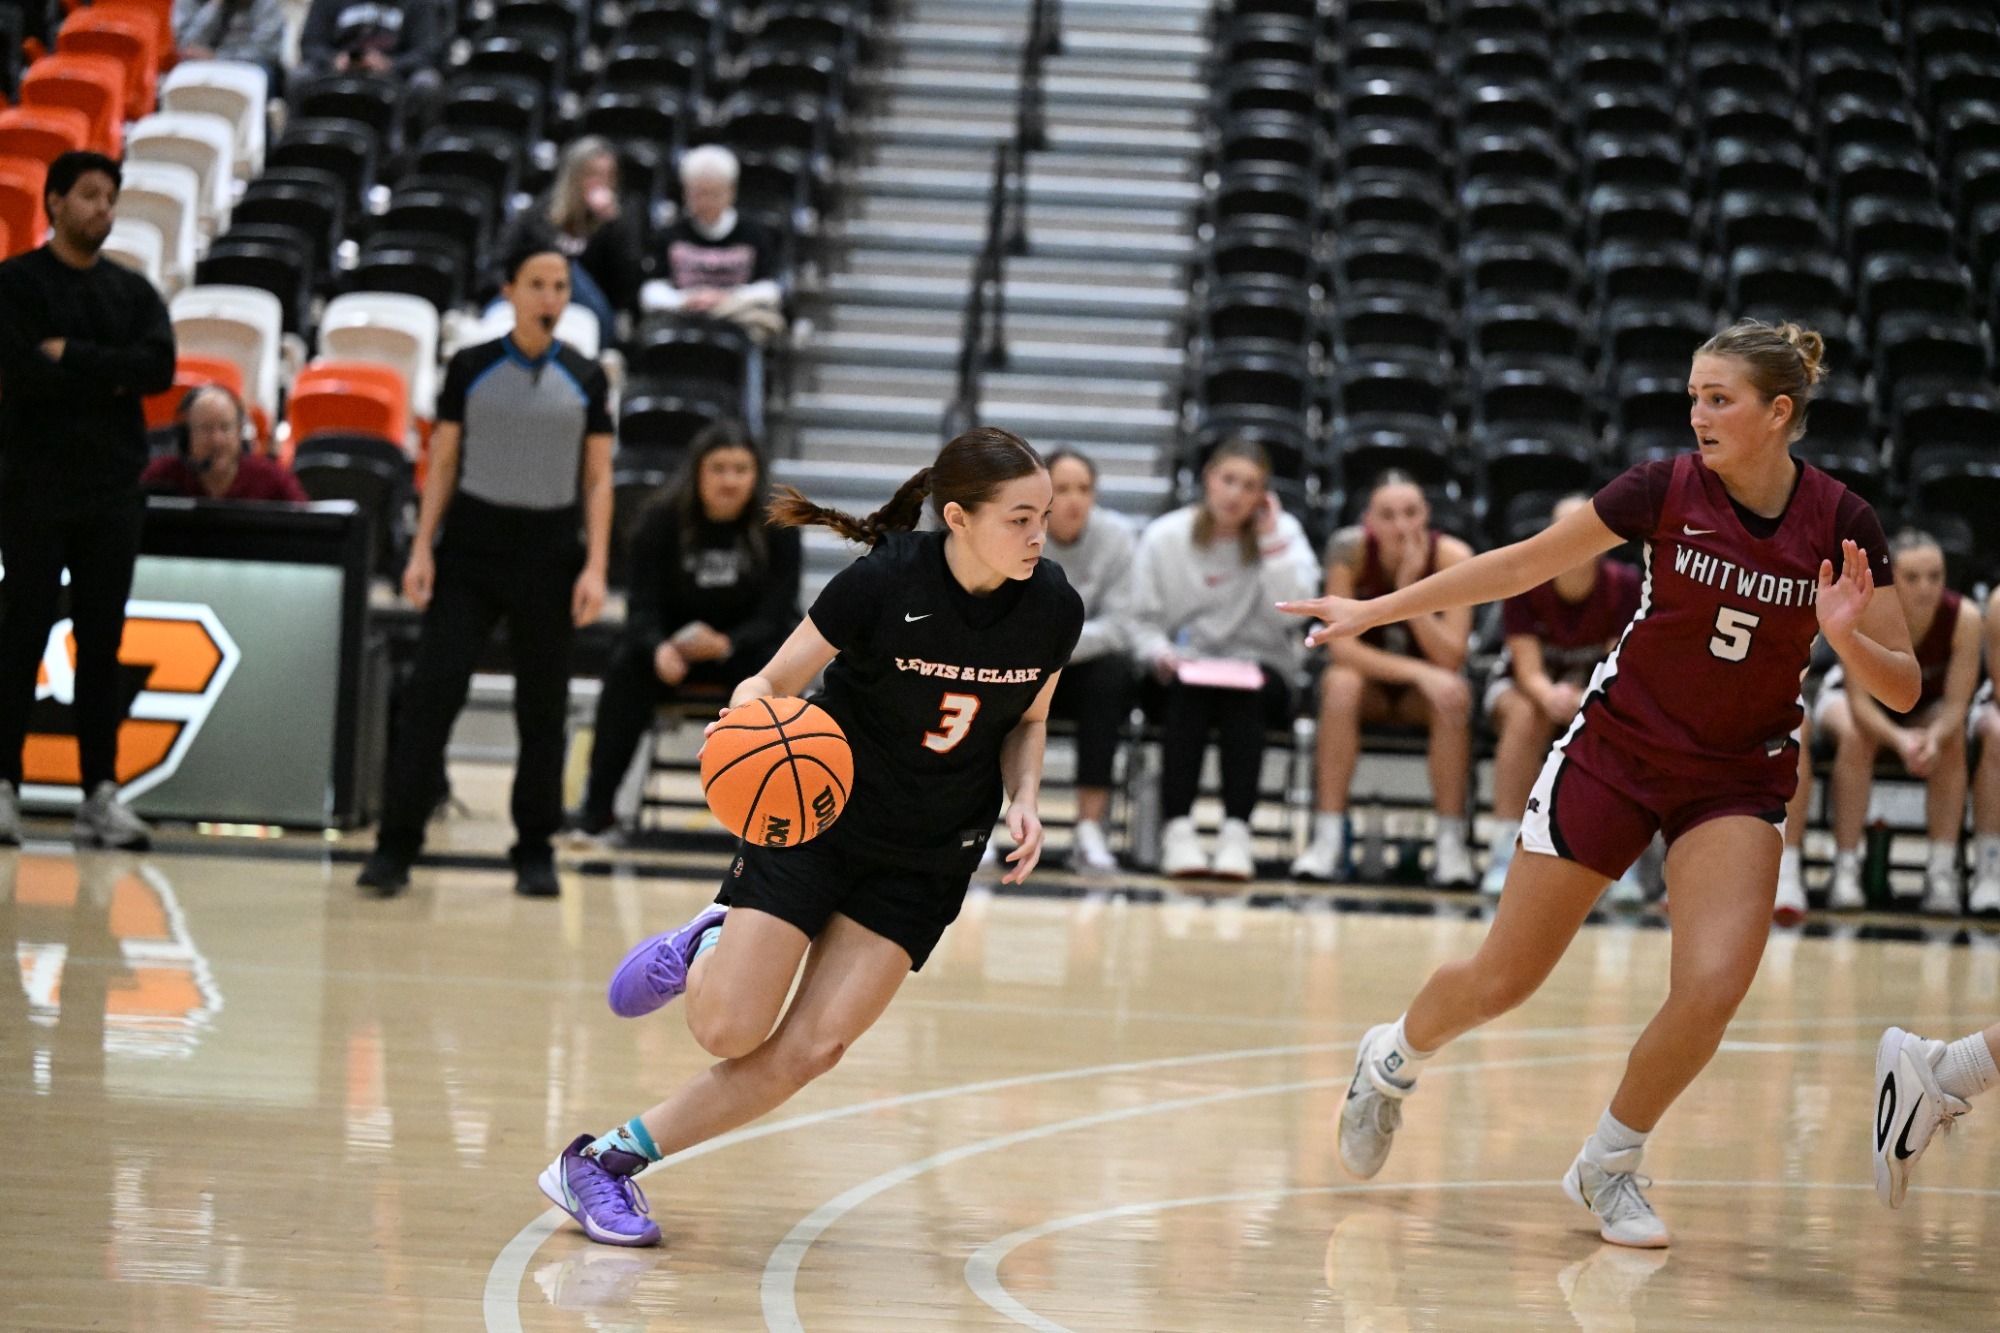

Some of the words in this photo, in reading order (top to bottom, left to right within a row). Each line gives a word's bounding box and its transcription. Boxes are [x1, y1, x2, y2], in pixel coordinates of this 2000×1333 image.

[1674, 544, 1819, 607] WHITWORTH
[1708, 604, 1761, 663] 5
[895, 657, 960, 680] LEWIS
[961, 667, 975, 681] &
[977, 668, 1042, 683] CLARK
[921, 692, 981, 754] 3
